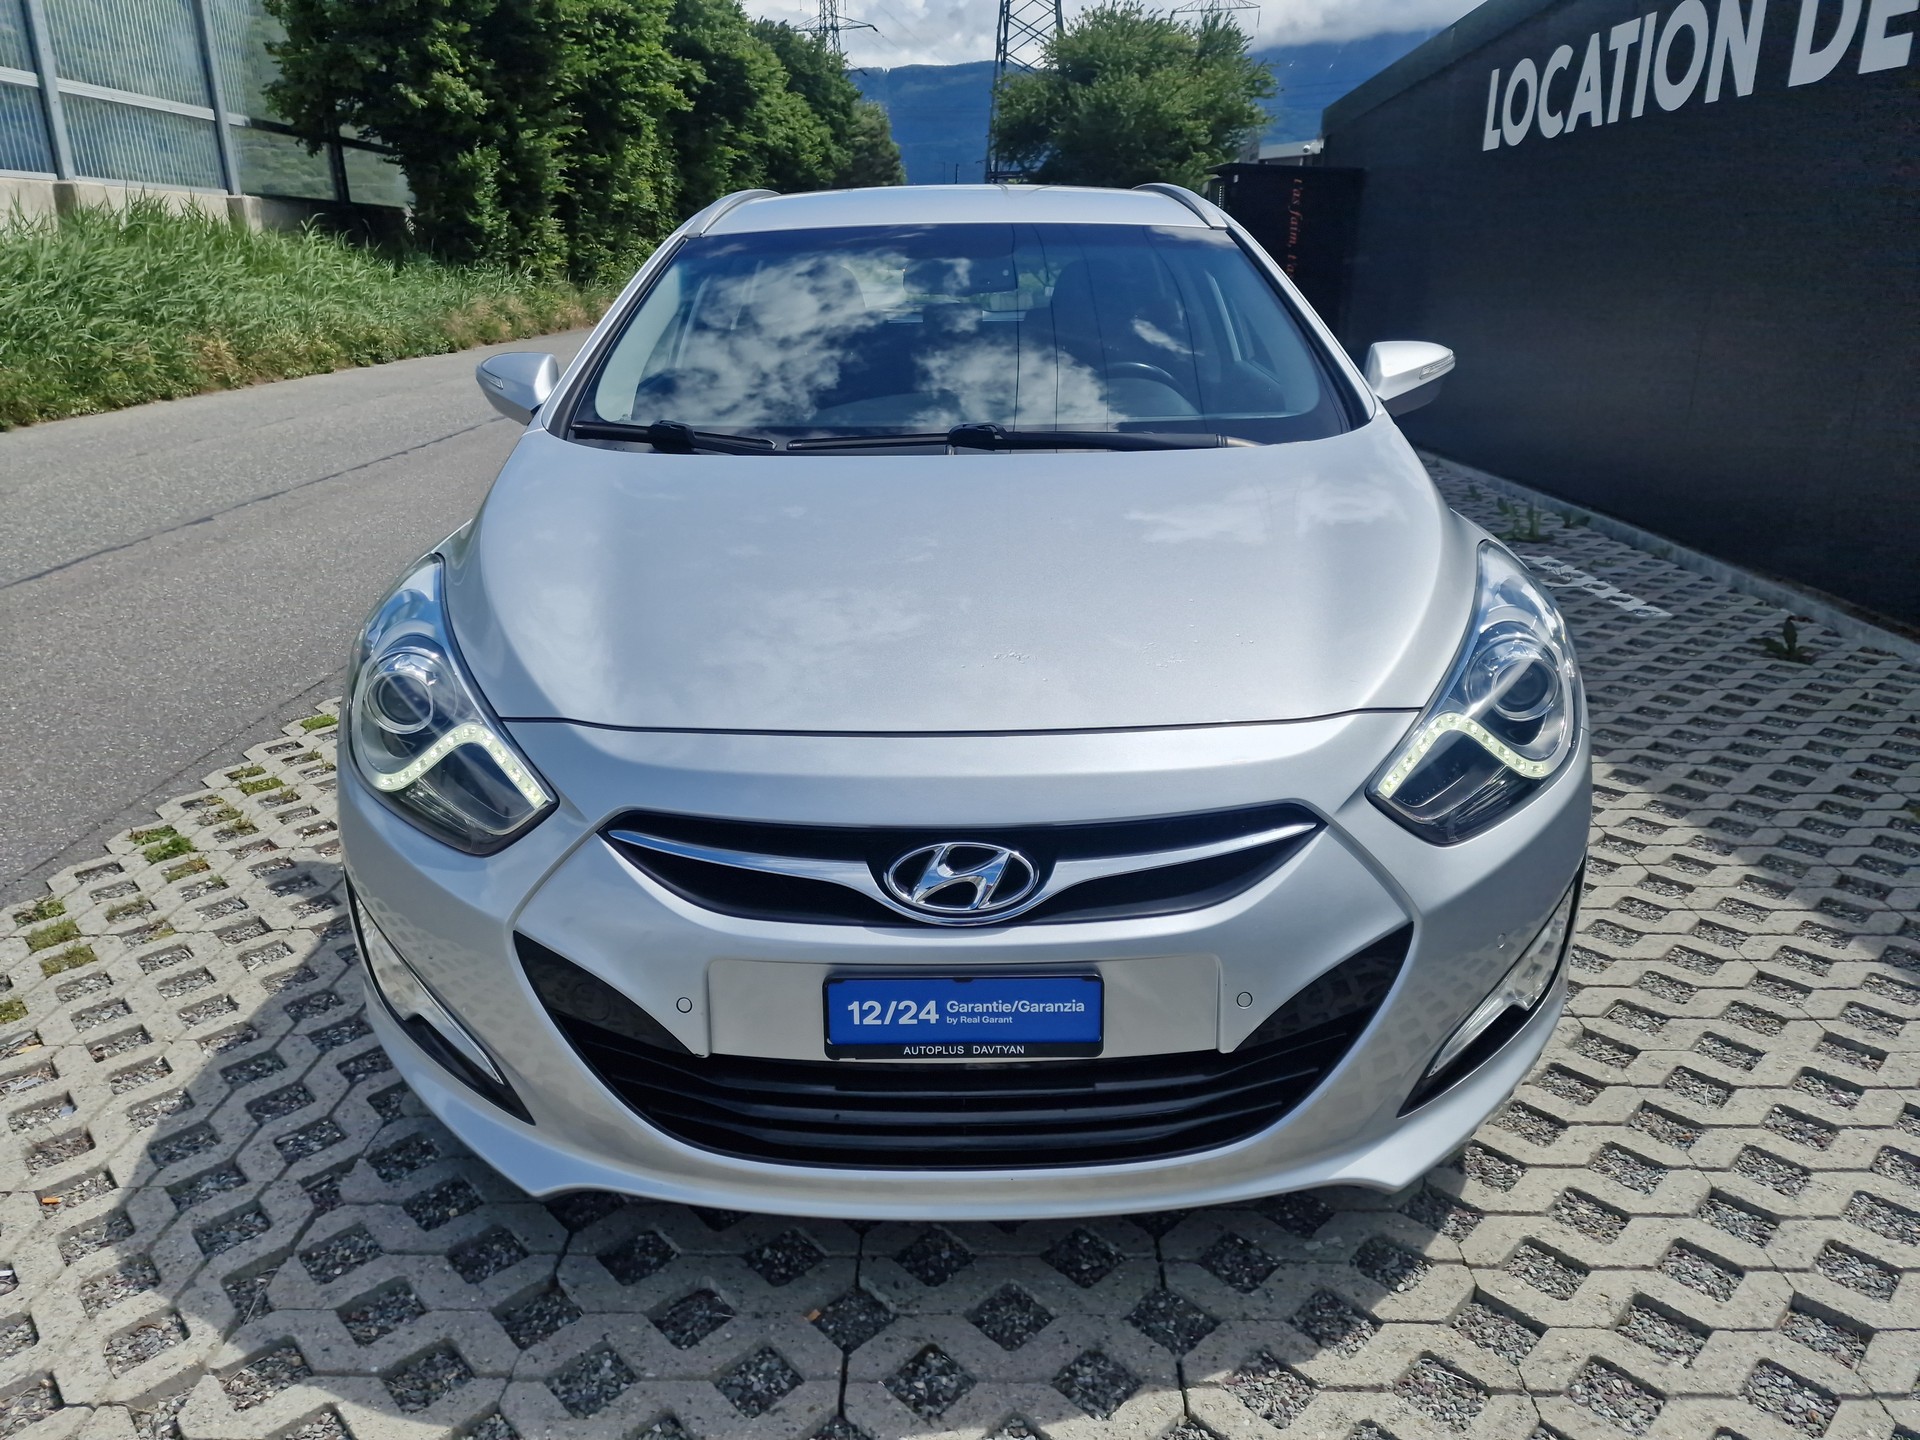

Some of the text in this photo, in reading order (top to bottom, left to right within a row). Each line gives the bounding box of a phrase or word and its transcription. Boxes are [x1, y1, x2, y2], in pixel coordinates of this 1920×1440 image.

[1482, 0, 1767, 151] LOCATION
[847, 1000, 940, 1025] 12/24
[946, 999, 1085, 1013] Garantie/Garanzia
[946, 1016, 1013, 1025] by Real Garant
[903, 1045, 1025, 1055] AUTOPLUS DAVTYAN
